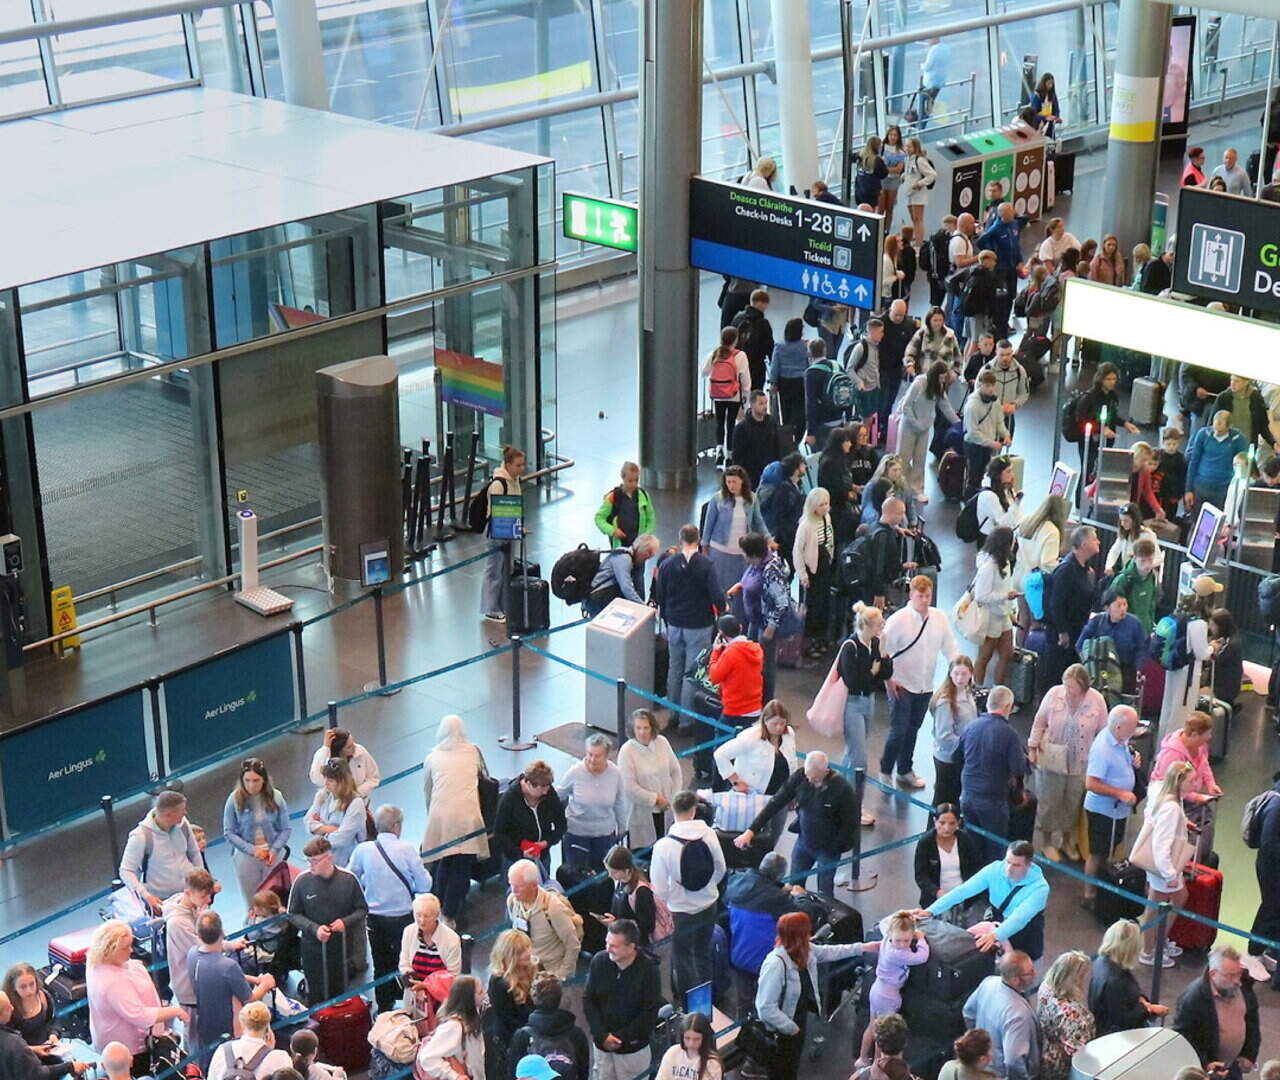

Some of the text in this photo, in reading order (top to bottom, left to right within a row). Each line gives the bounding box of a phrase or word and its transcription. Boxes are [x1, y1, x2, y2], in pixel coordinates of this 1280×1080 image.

[729, 192, 793, 213] Deasca Cláraithe
[735, 206, 793, 227] Check-in Desks
[795, 209, 832, 234] 1-28
[808, 238, 832, 251] Ticéid
[803, 251, 831, 265] Tickets
[204, 697, 245, 720] Aer Lingus
[47, 757, 94, 781] Aer Lingus
